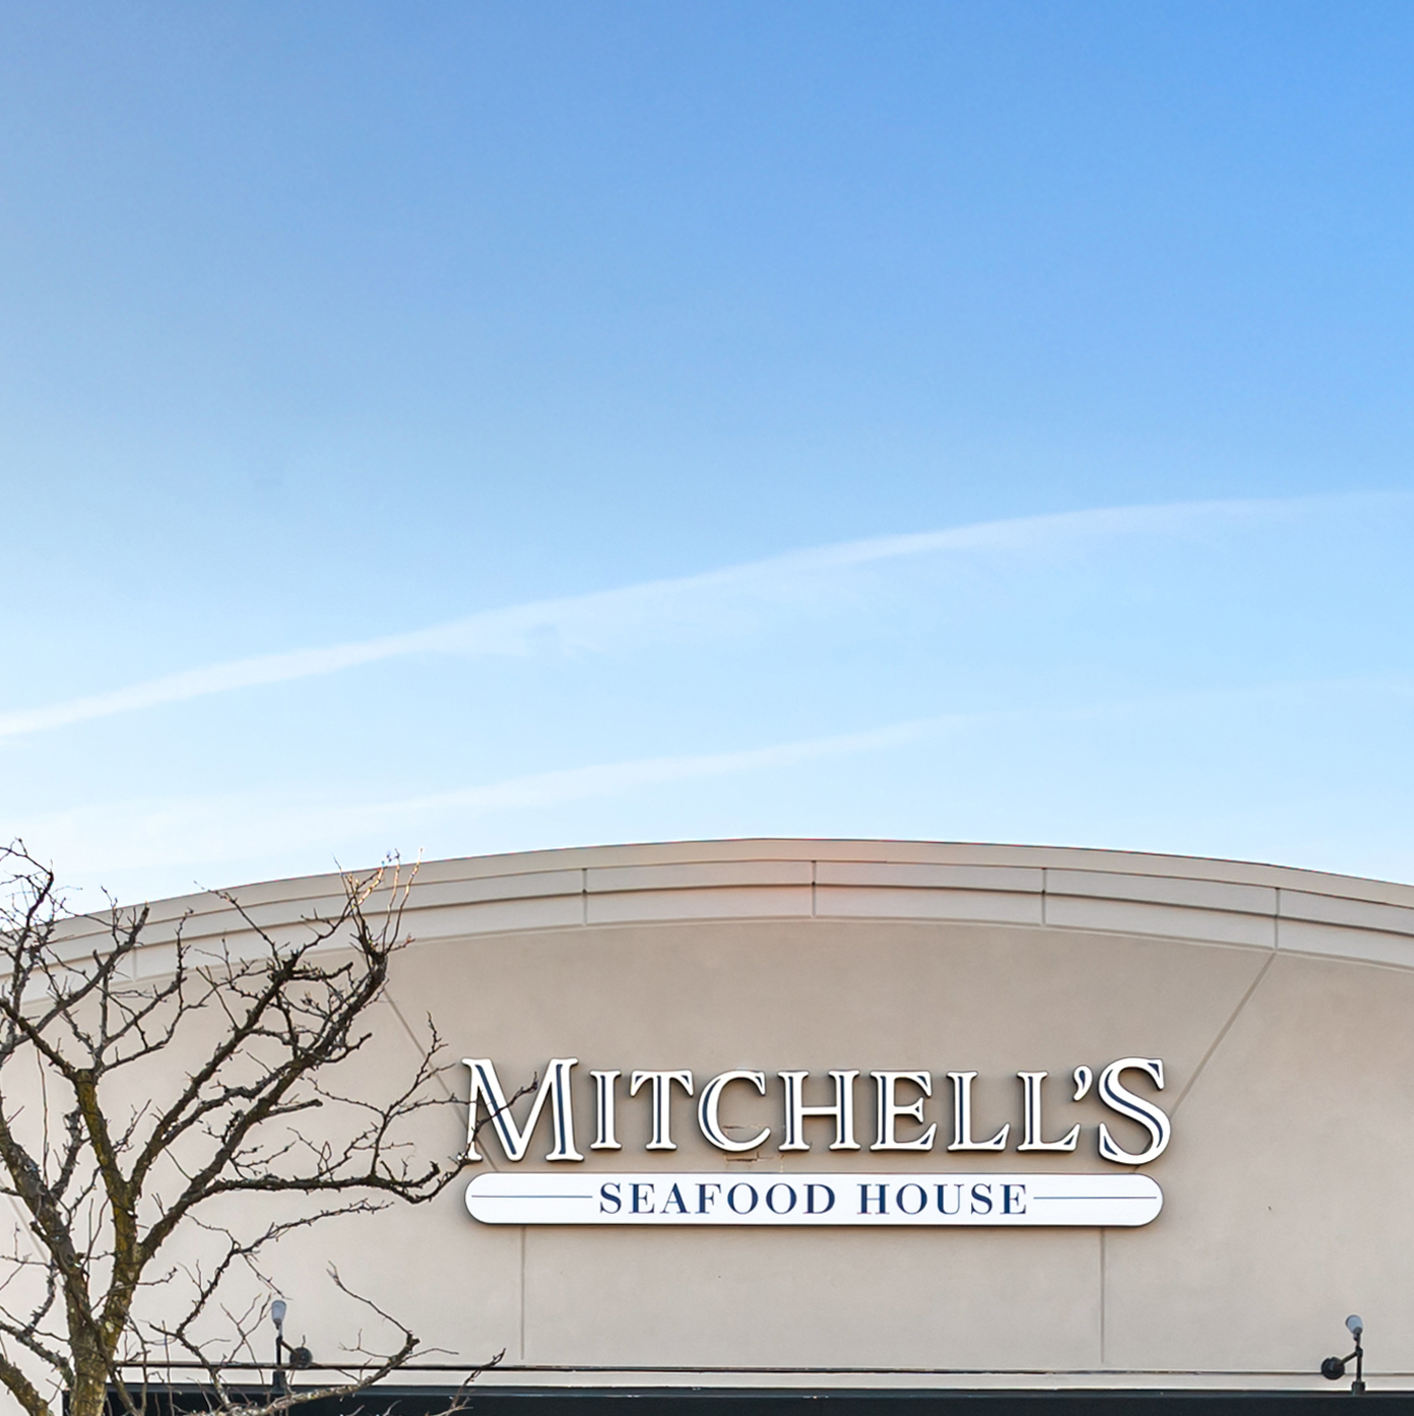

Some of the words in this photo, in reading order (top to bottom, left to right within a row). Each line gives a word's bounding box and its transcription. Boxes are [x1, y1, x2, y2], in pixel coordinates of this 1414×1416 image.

[460, 1056, 1172, 1167] MITCHELL'S
[599, 1182, 836, 1216] SEAFOOD
[856, 1183, 1029, 1217] HOUSE
